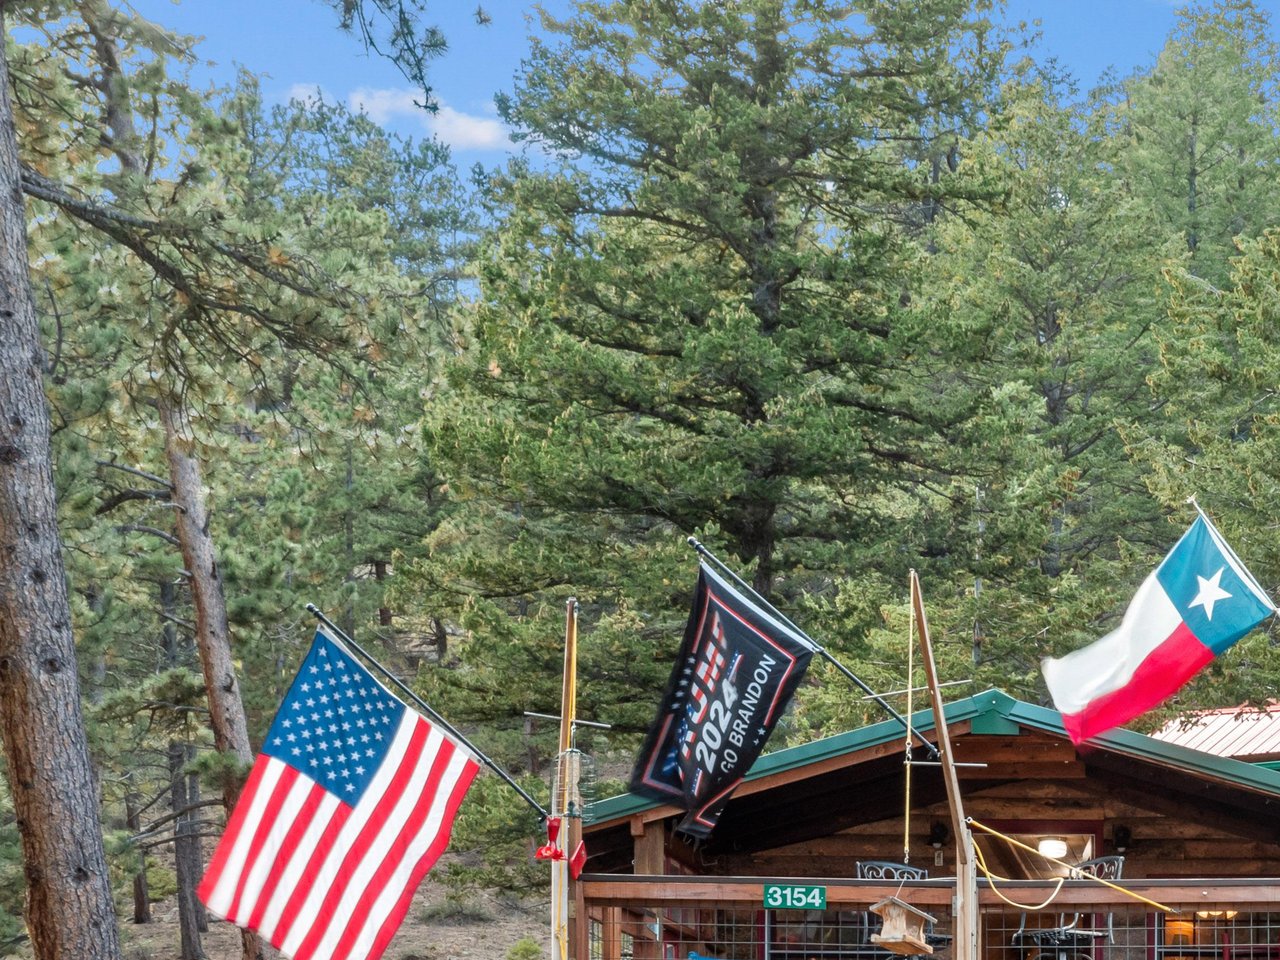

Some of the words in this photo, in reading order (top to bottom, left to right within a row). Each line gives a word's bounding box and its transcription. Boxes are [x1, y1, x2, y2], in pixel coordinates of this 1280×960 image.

[696, 678, 738, 774] 2024
[729, 653, 777, 747] BRANDON
[721, 749, 738, 773] GO
[767, 886, 822, 907] 3154
